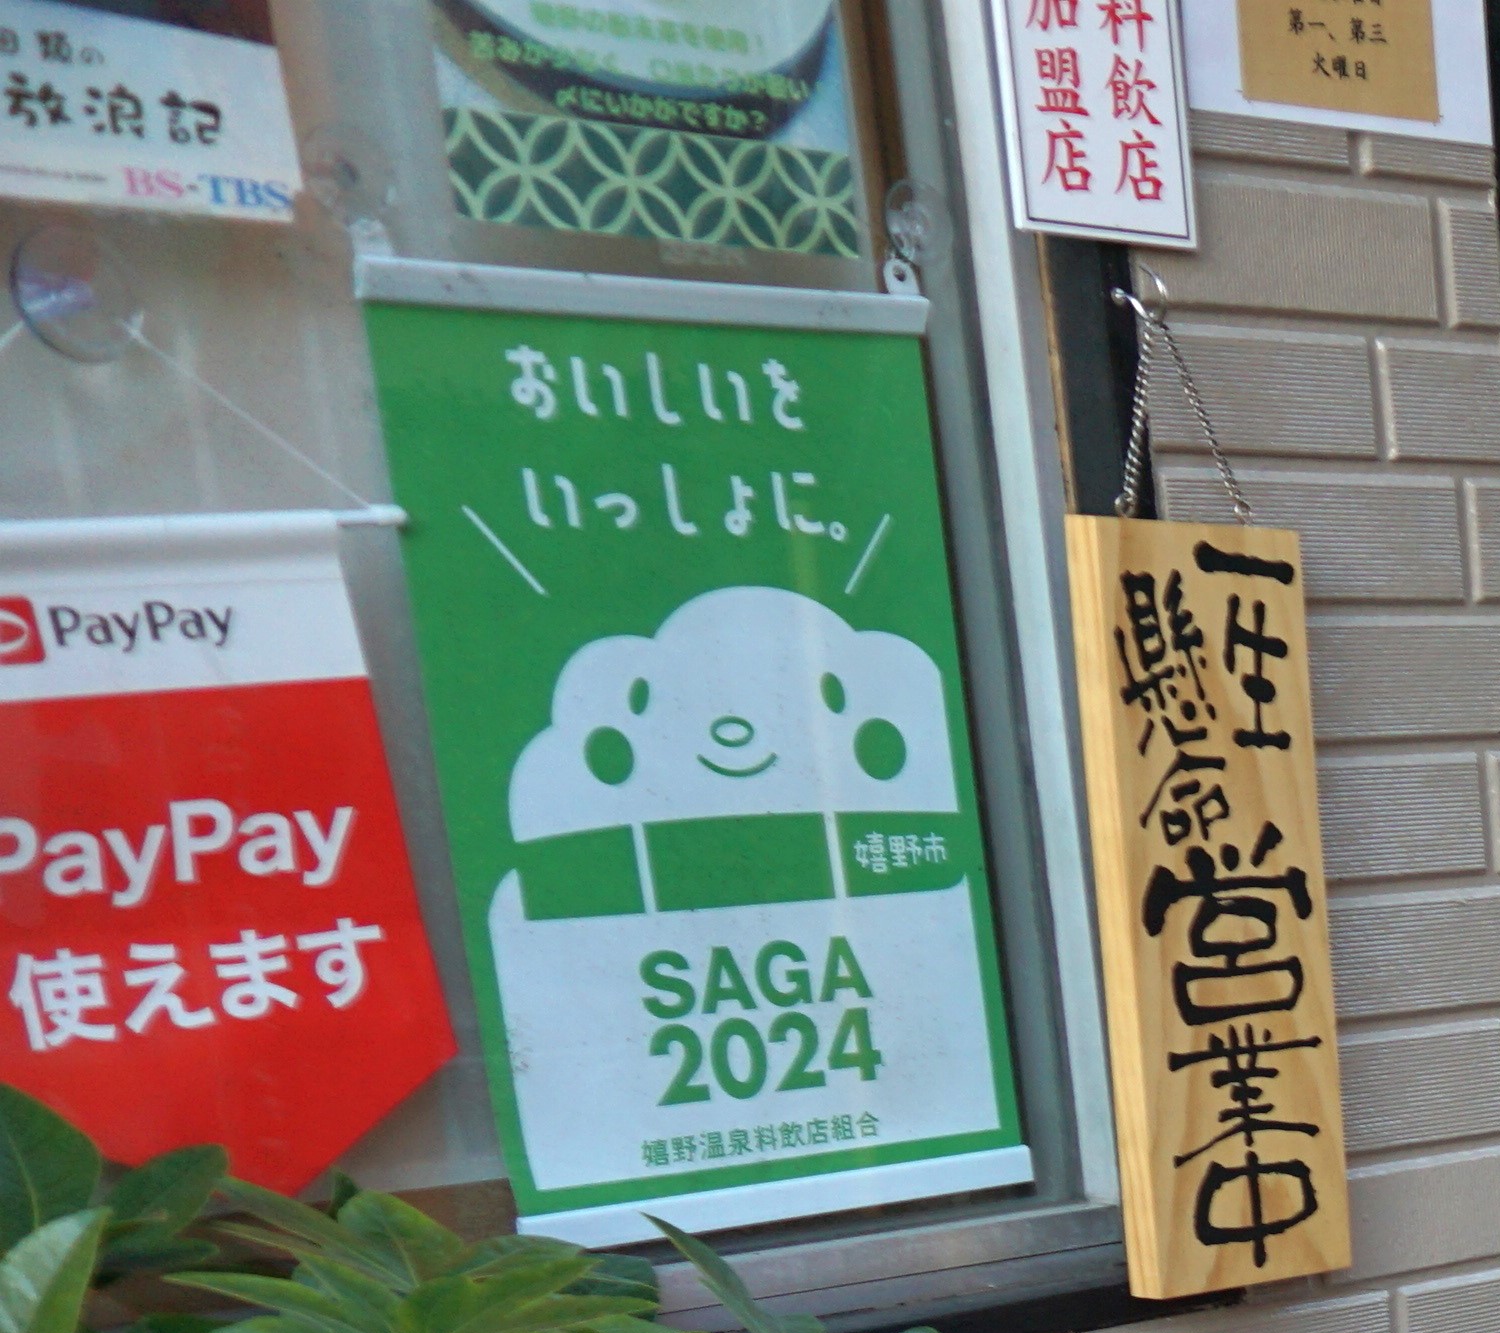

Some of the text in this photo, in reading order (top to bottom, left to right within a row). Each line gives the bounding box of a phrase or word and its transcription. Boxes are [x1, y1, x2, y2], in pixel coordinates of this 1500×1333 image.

[1311, 52, 1369, 81] 火曜日
[506, 342, 805, 431] おいしいを
[522, 462, 849, 545] いっしょに。
[48, 601, 233, 654] PayPay
[0, 799, 353, 908] PayPay
[853, 831, 947, 874] 嬉野市
[10, 917, 385, 1053] 使えます
[638, 934, 874, 1021] SAGA
[647, 1007, 884, 1109] 2024
[1140, 820, 1323, 1270] 営業中
[640, 1110, 880, 1168] 嬉野温泉料飲店組合
